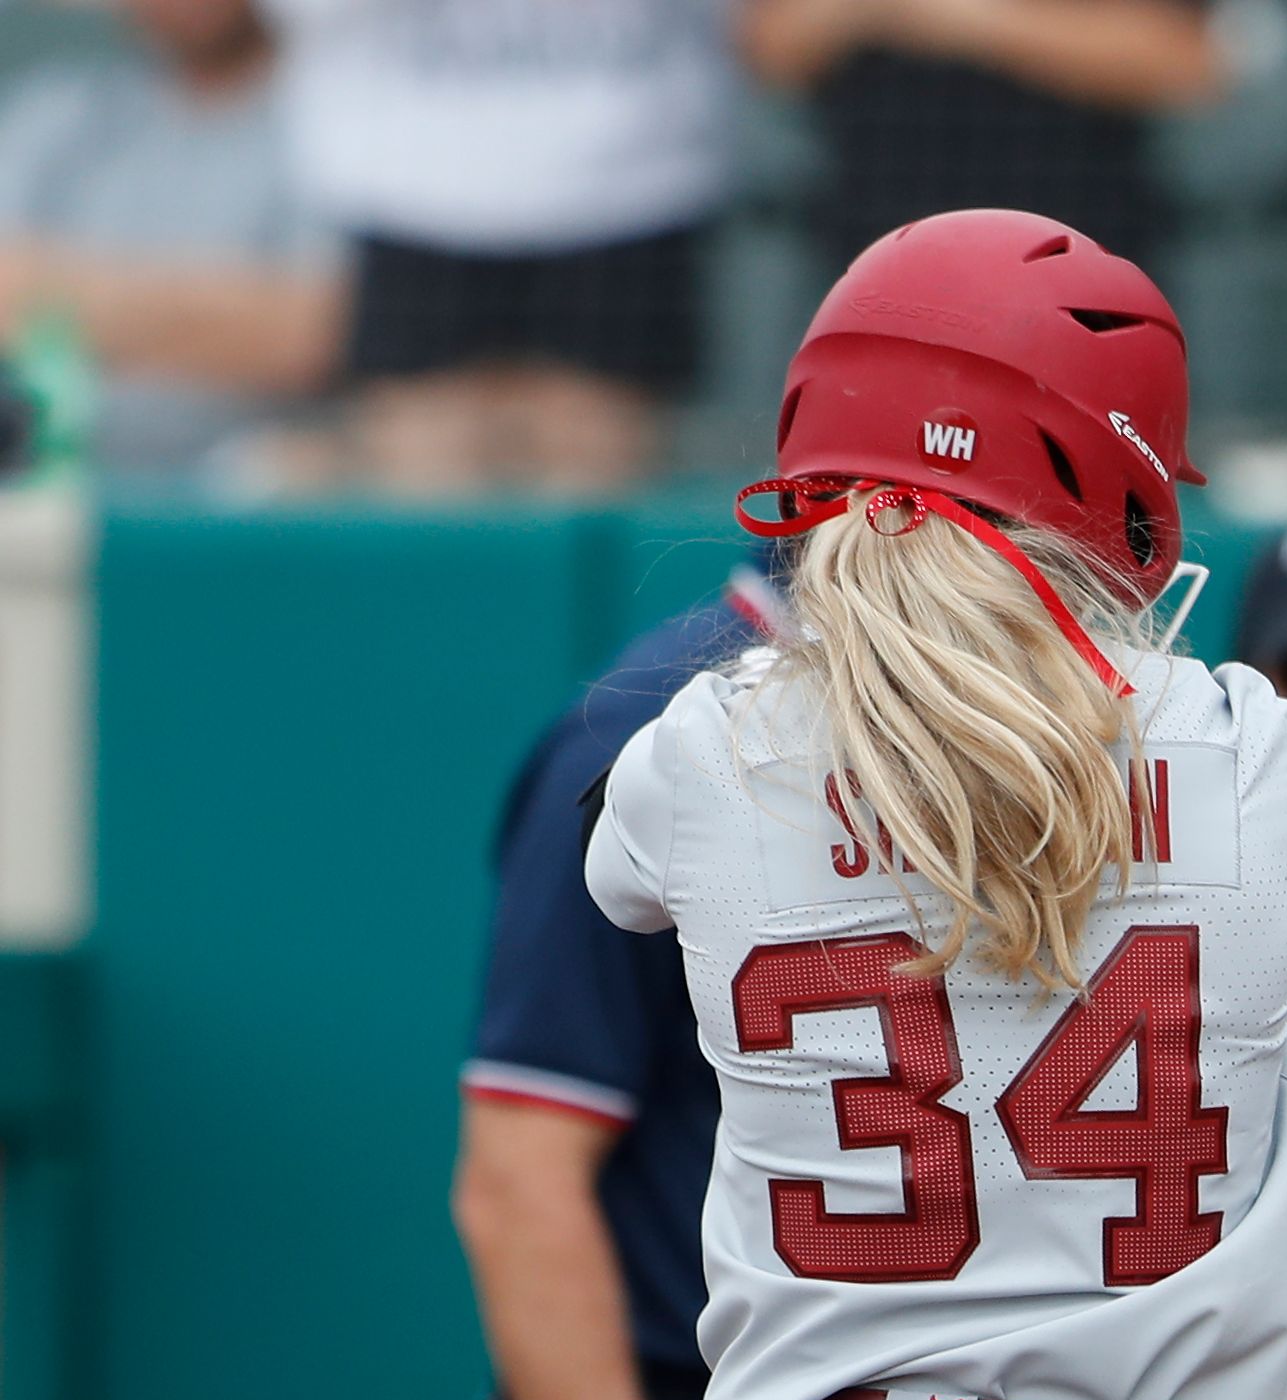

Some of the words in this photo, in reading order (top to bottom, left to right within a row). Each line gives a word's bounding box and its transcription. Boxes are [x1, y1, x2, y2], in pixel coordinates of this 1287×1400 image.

[923, 420, 976, 462] WH
[1122, 424, 1170, 482] EASTON
[731, 924, 1229, 1288] 34
